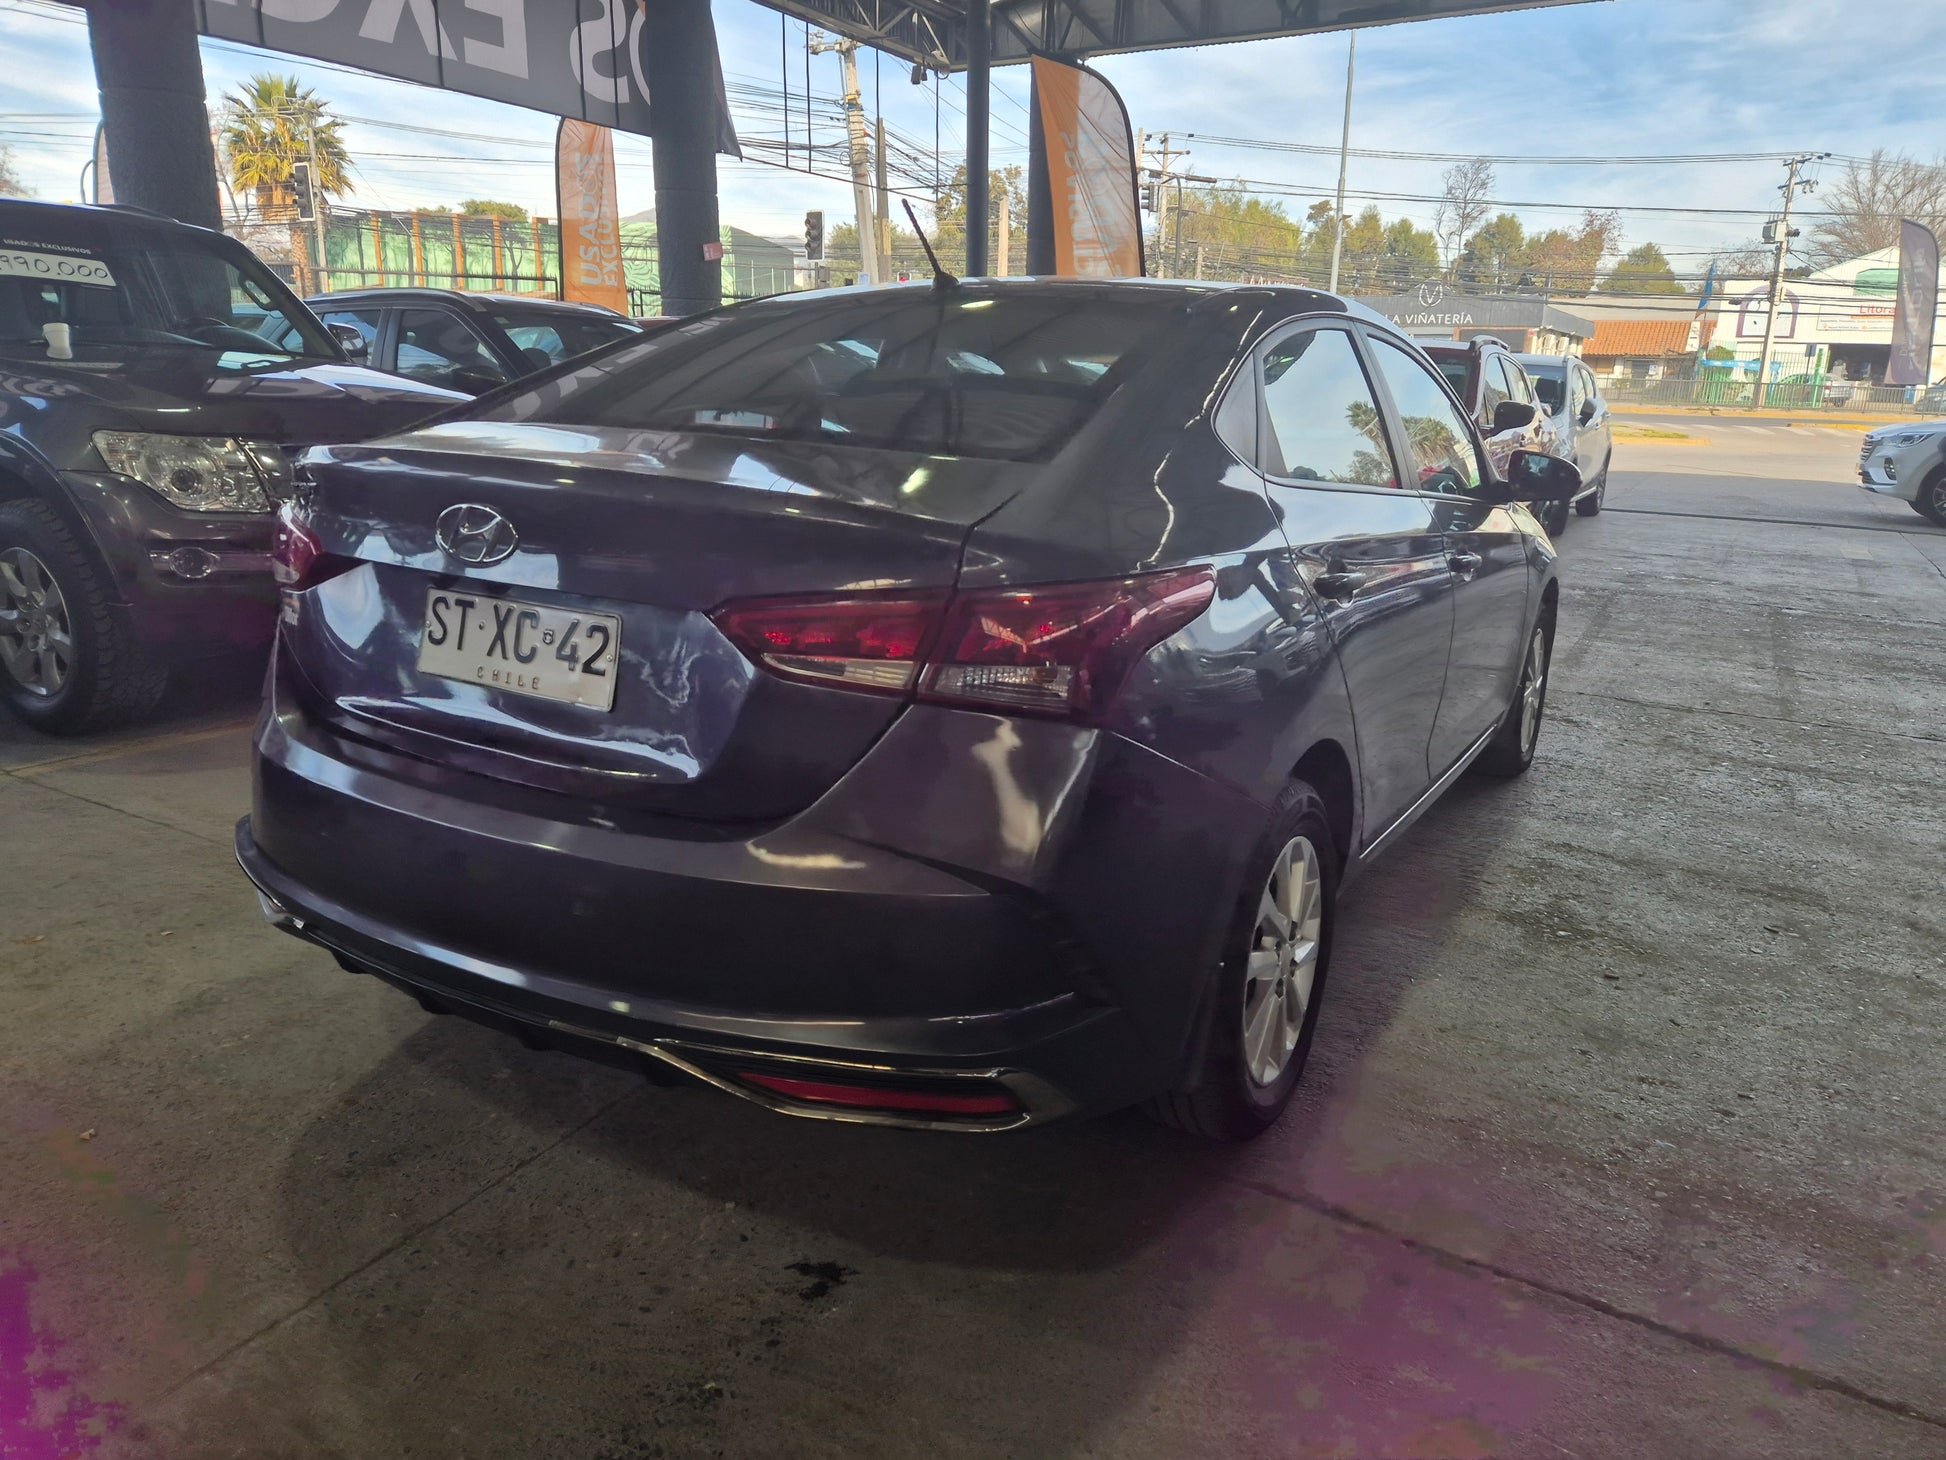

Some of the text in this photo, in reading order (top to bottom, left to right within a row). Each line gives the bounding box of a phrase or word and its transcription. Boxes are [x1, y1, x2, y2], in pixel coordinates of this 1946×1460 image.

[574, 152, 602, 287] USADOS
[41, 242, 92, 255] EXCLUSIVOS
[1405, 311, 1473, 325] VIÑATERÍA
[476, 665, 541, 690] CHILE
